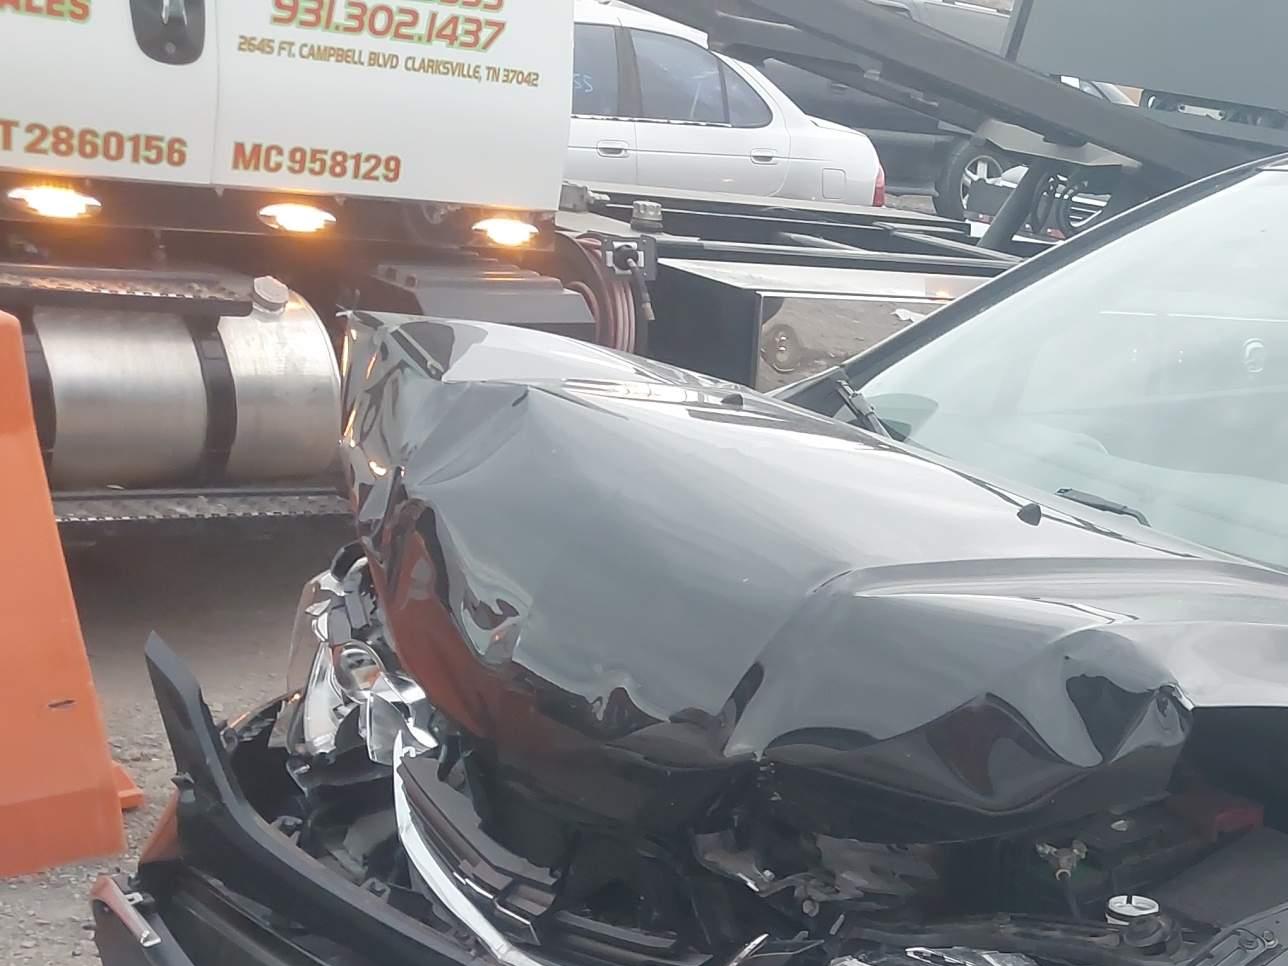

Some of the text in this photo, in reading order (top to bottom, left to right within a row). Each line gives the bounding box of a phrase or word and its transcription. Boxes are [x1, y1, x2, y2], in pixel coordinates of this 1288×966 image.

[272, 0, 506, 50] 931.302.1437
[238, 35, 540, 87] 2645 FT. CAMPBELL BLVD CLARKSVILLE, TN 37042
